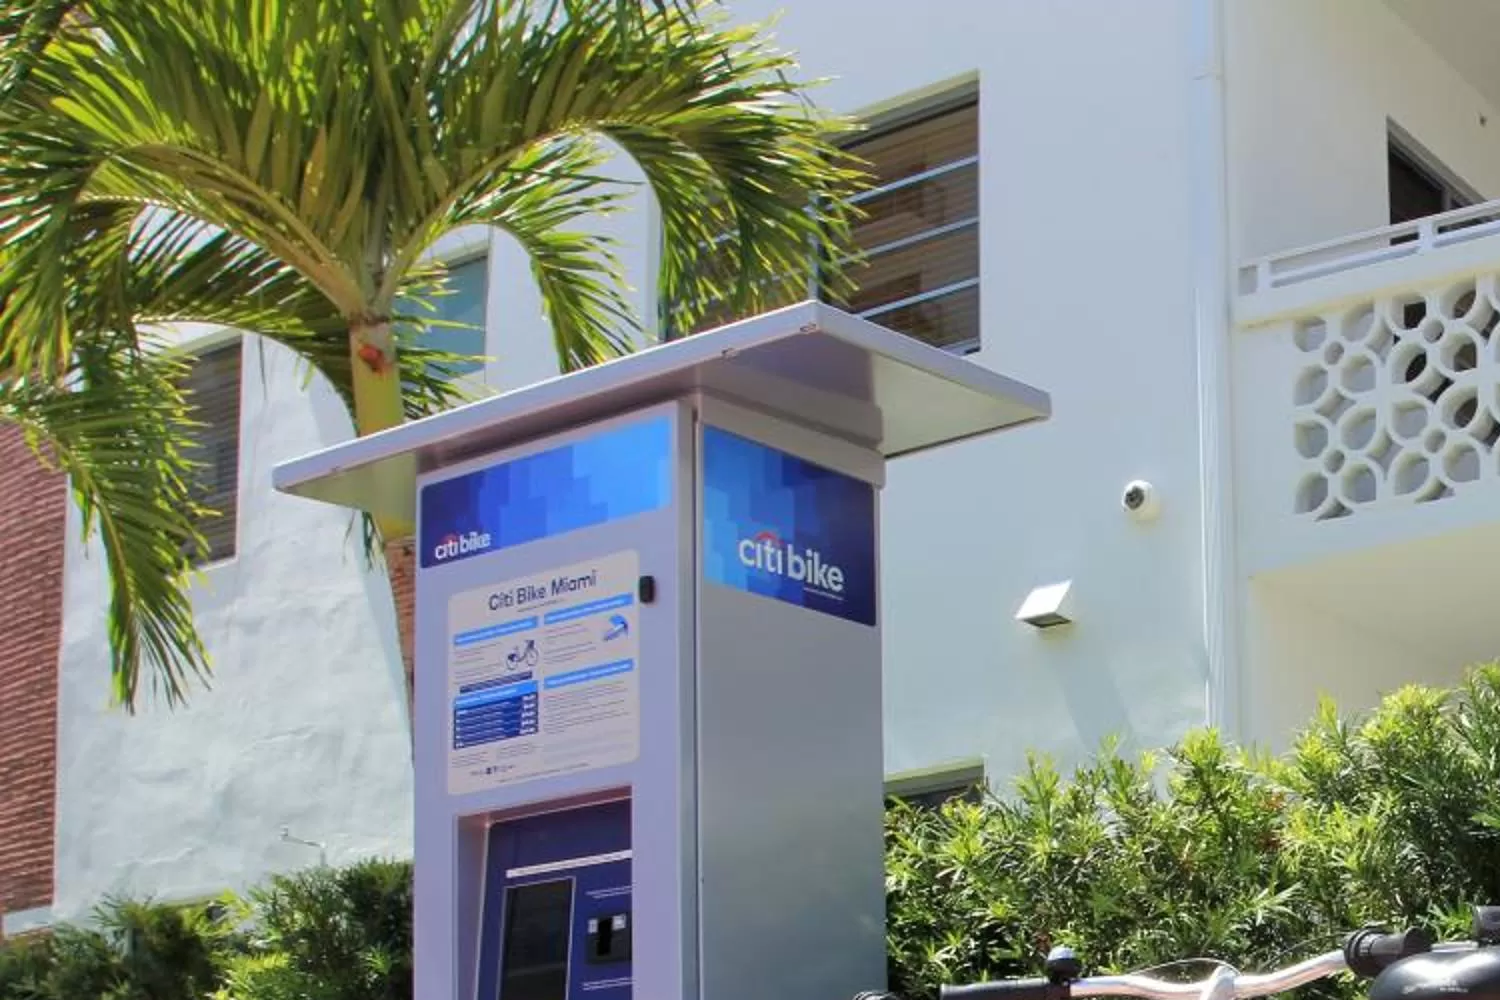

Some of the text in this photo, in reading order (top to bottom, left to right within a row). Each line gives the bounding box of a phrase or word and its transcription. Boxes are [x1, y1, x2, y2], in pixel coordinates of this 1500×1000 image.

[435, 531, 491, 559] citi bike
[740, 532, 844, 592] citi bike
[488, 589, 514, 611] Citi
[517, 585, 546, 605] Bike
[551, 569, 597, 596] Miami
